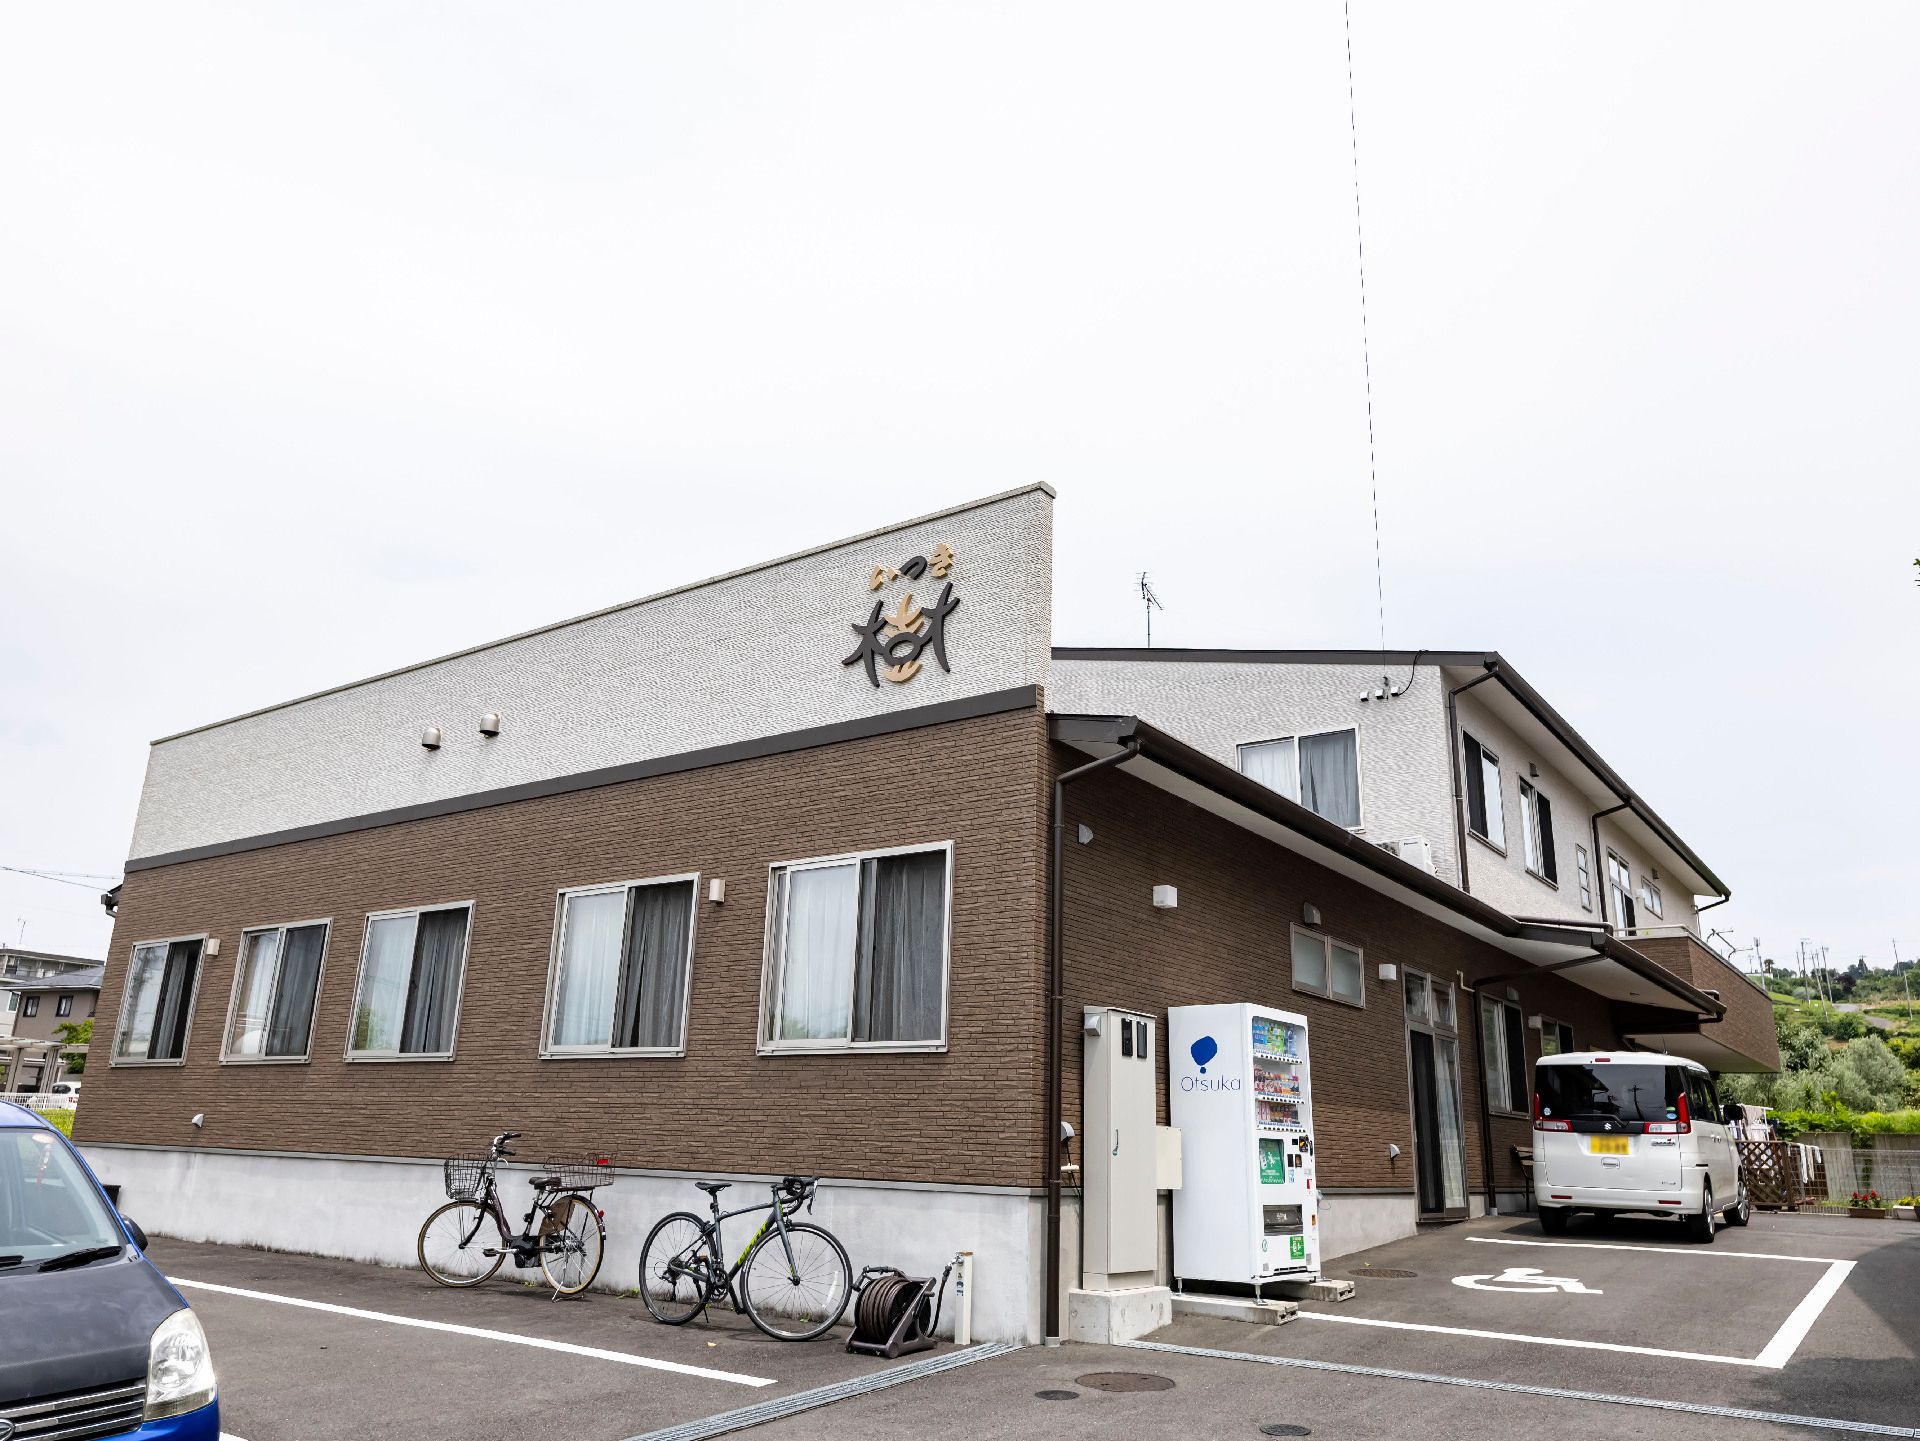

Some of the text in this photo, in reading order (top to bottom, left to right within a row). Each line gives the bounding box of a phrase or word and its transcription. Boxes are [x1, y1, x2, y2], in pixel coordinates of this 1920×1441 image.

[869, 543, 954, 591] いつき
[1181, 1074, 1241, 1092] Otsuka
